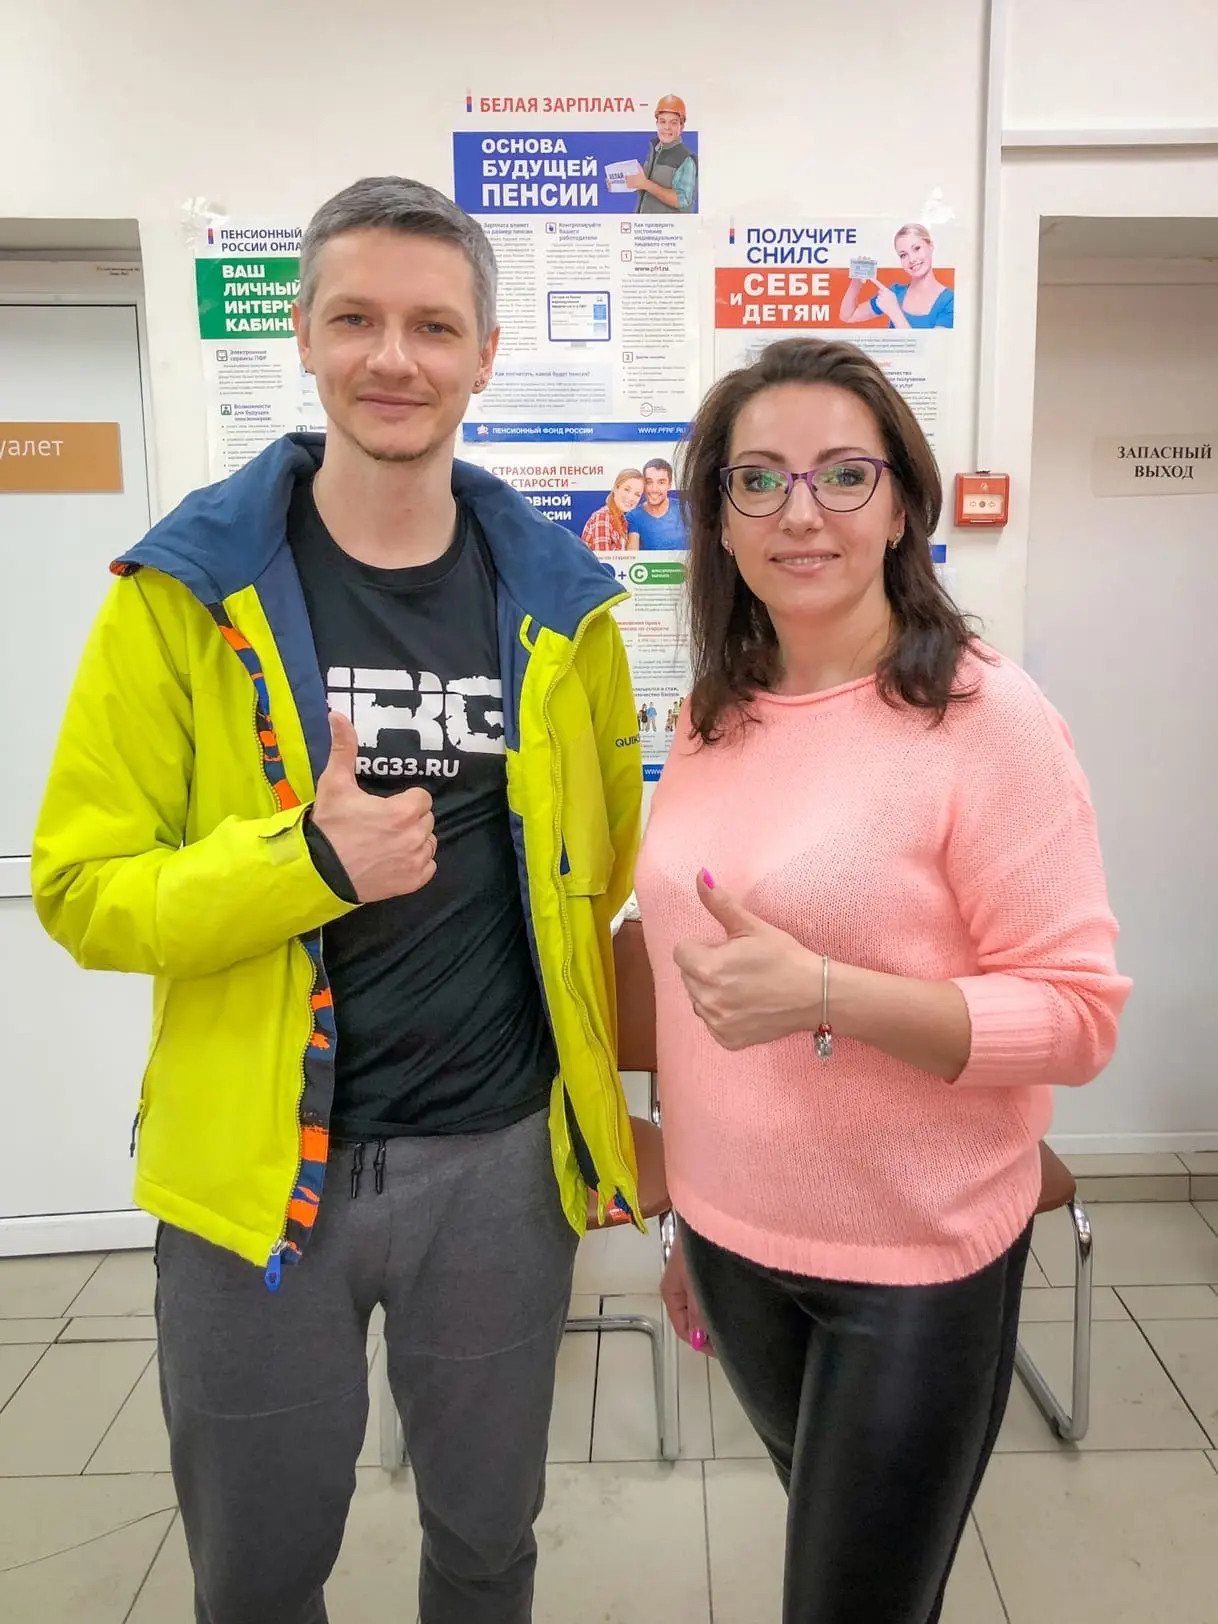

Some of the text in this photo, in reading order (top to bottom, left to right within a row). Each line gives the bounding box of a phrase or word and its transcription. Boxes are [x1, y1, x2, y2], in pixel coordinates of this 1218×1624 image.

[480, 97, 538, 113] БЕЛАЯ
[543, 97, 635, 113] ЗАРПЛАТА
[481, 138, 568, 154] ОСНОВА
[482, 156, 598, 180] БУДУЩЕЙ
[482, 183, 599, 207] ПЕНСИИ
[220, 226, 303, 241] ПЕНСИОННЫЙ
[747, 228, 857, 244] ПОЛУЧИТЕ
[221, 242, 268, 253] РОССИИ
[746, 246, 829, 264] СНИЛС
[222, 264, 265, 278] ВАШ
[223, 279, 302, 296] ЛИЧНЫЙ
[743, 273, 830, 296] СЕБЕ
[742, 304, 830, 325] ДЕТЯМ
[492, 426, 593, 436] ПЕНСИОННЫЙ ФОНД РОССИИ
[1117, 443, 1212, 459] ЗАПАСНЫЙ
[492, 465, 604, 476] СТРАХОВАЯ ПЕНСИЯ
[1135, 465, 1194, 480] ВЫХОД
[511, 478, 569, 488] СТАРОСТИ
